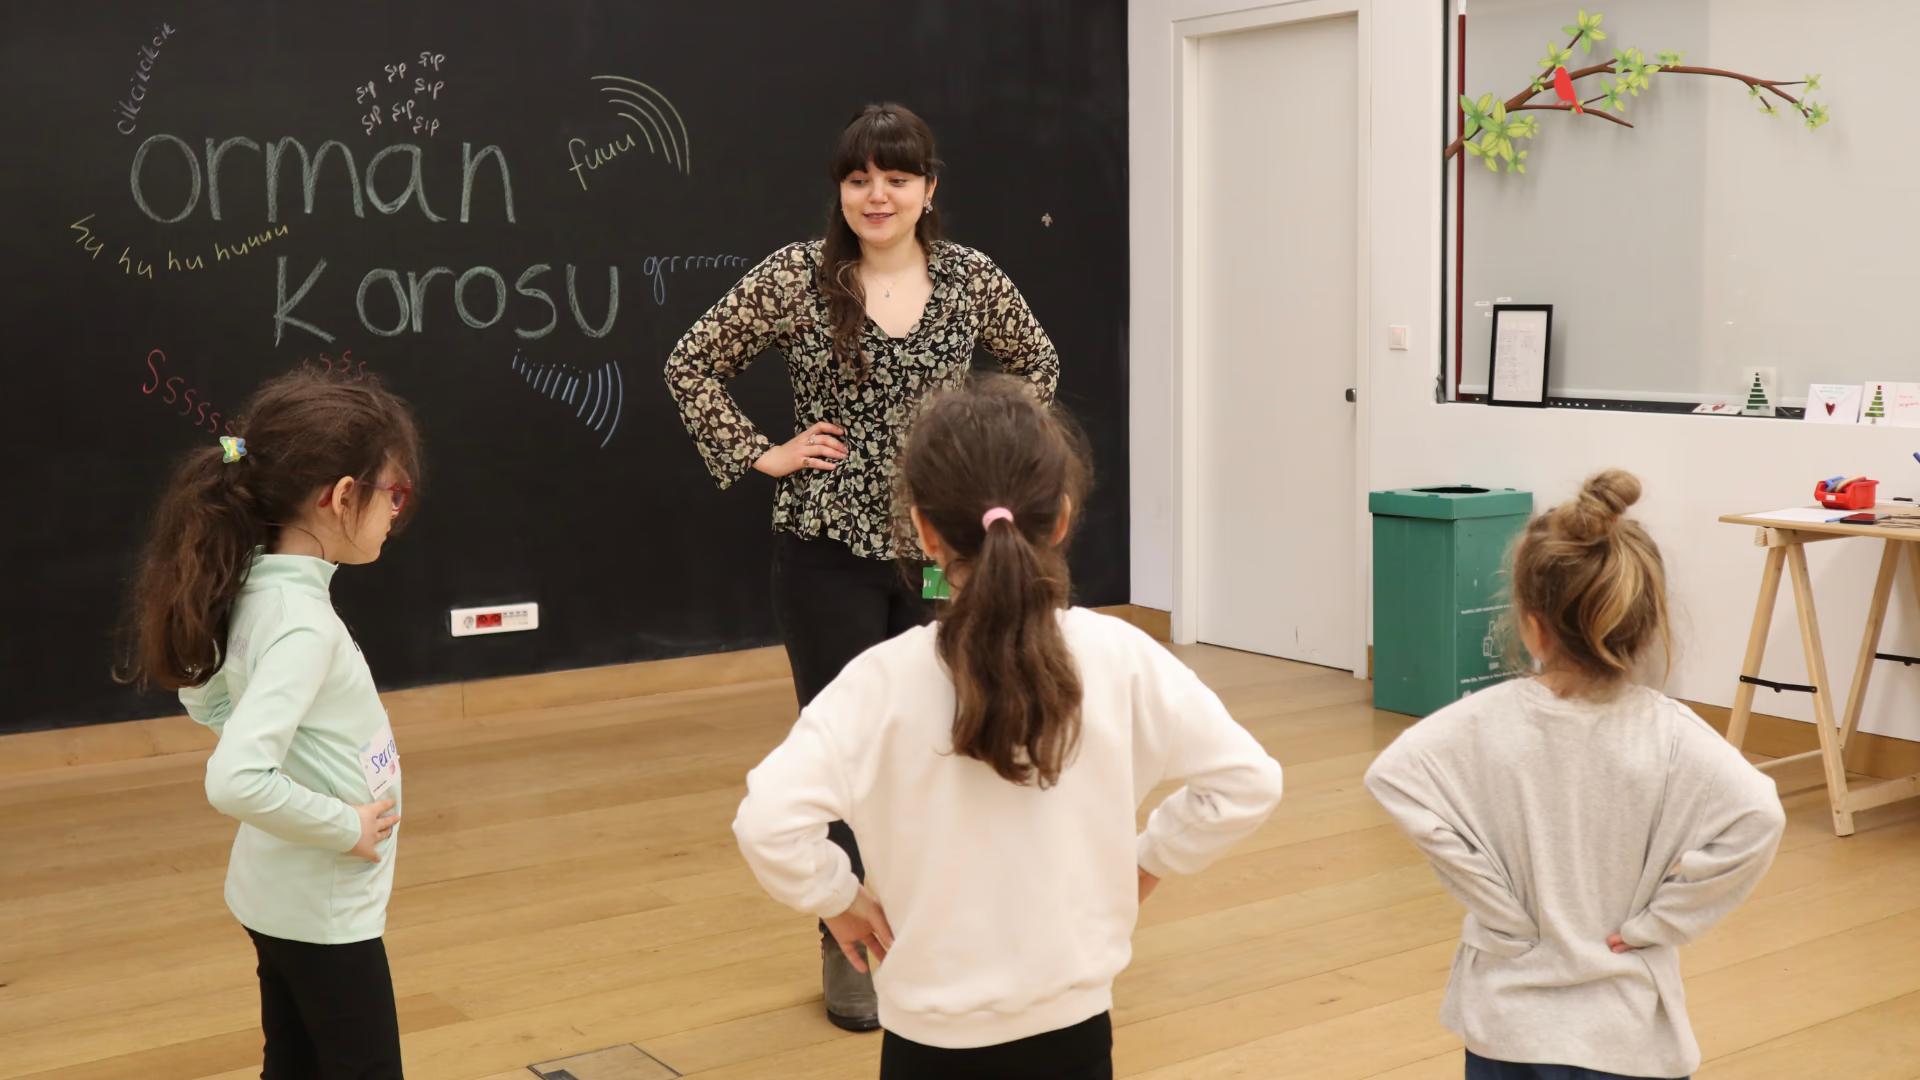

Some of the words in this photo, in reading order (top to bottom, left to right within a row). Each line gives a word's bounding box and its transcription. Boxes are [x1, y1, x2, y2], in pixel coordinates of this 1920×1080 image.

[130, 133, 516, 224] orman
[568, 133, 636, 191] fuuu
[118, 246, 153, 279] hu
[168, 250, 204, 272] hu
